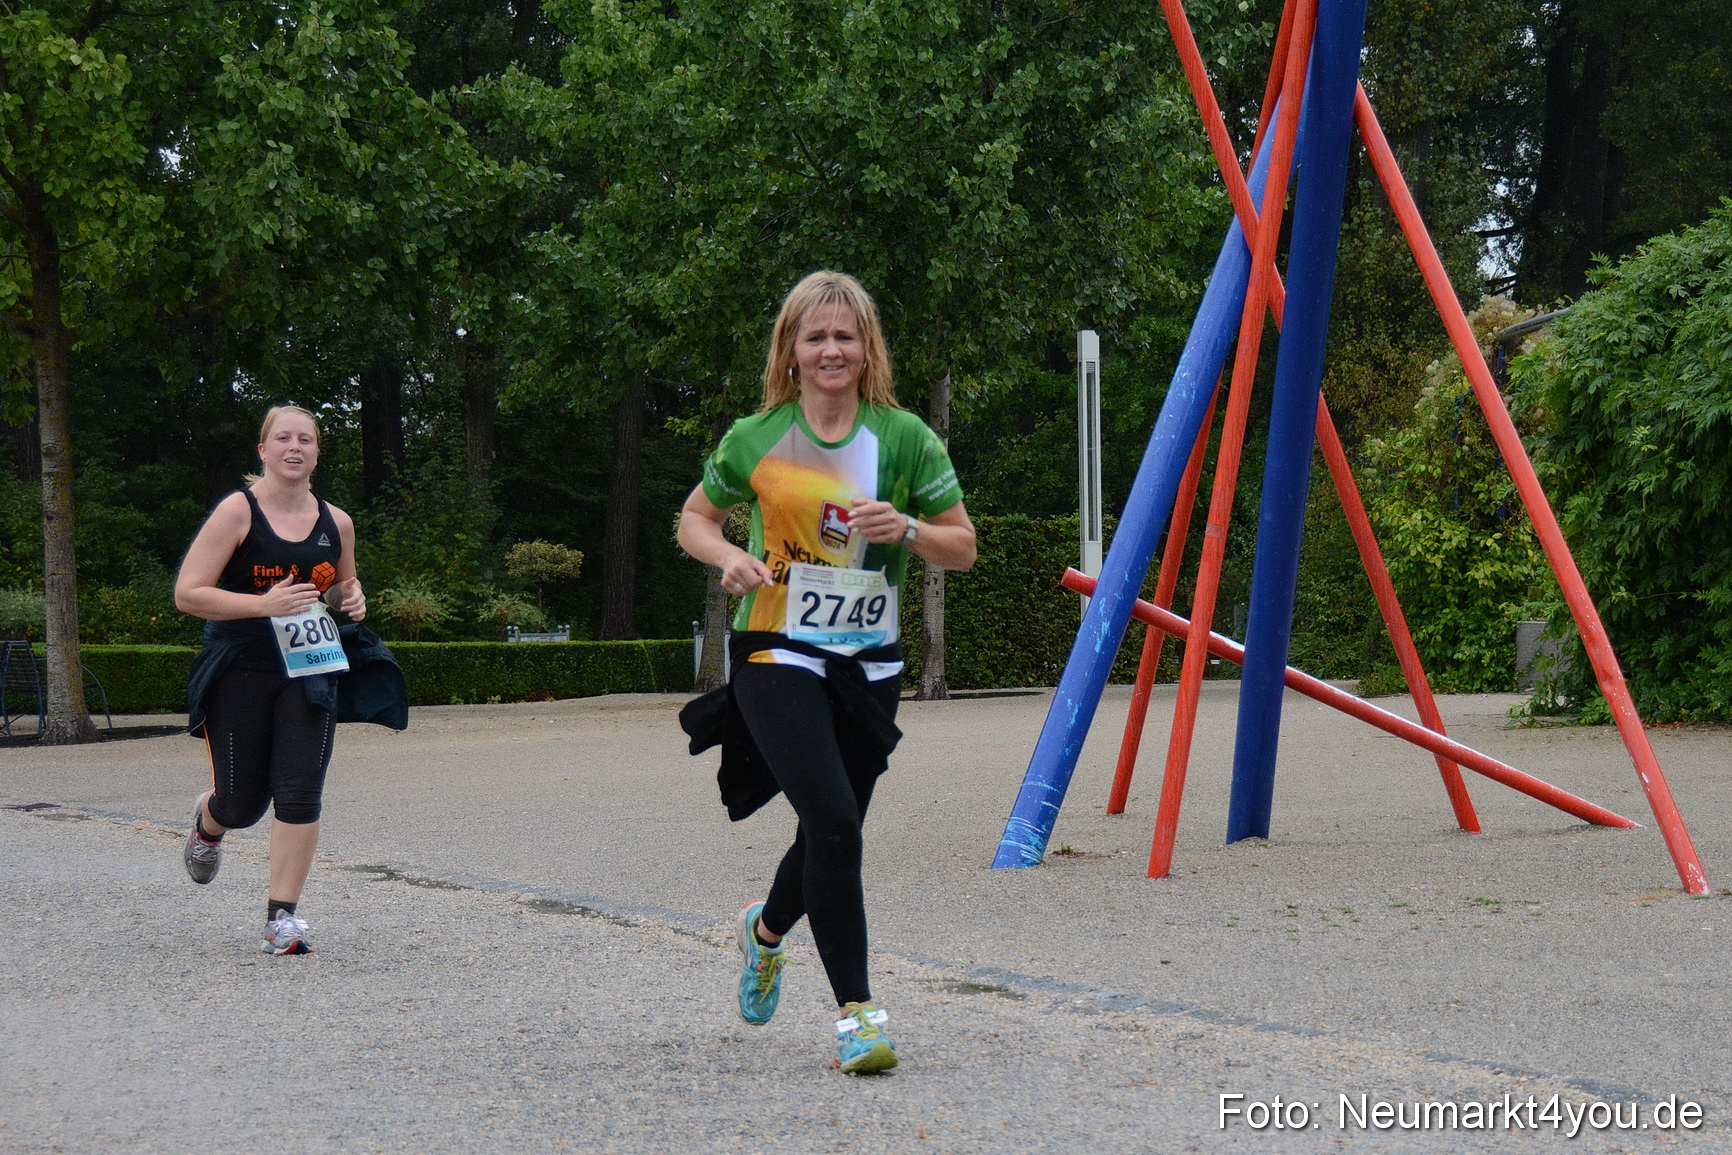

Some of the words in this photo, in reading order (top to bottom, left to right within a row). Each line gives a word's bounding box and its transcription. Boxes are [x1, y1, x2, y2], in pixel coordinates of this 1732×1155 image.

[253, 565, 285, 577] Fink
[290, 564, 300, 576] &
[800, 591, 887, 628] 2749
[284, 616, 341, 648] 280
[306, 650, 345, 665] Sabrina
